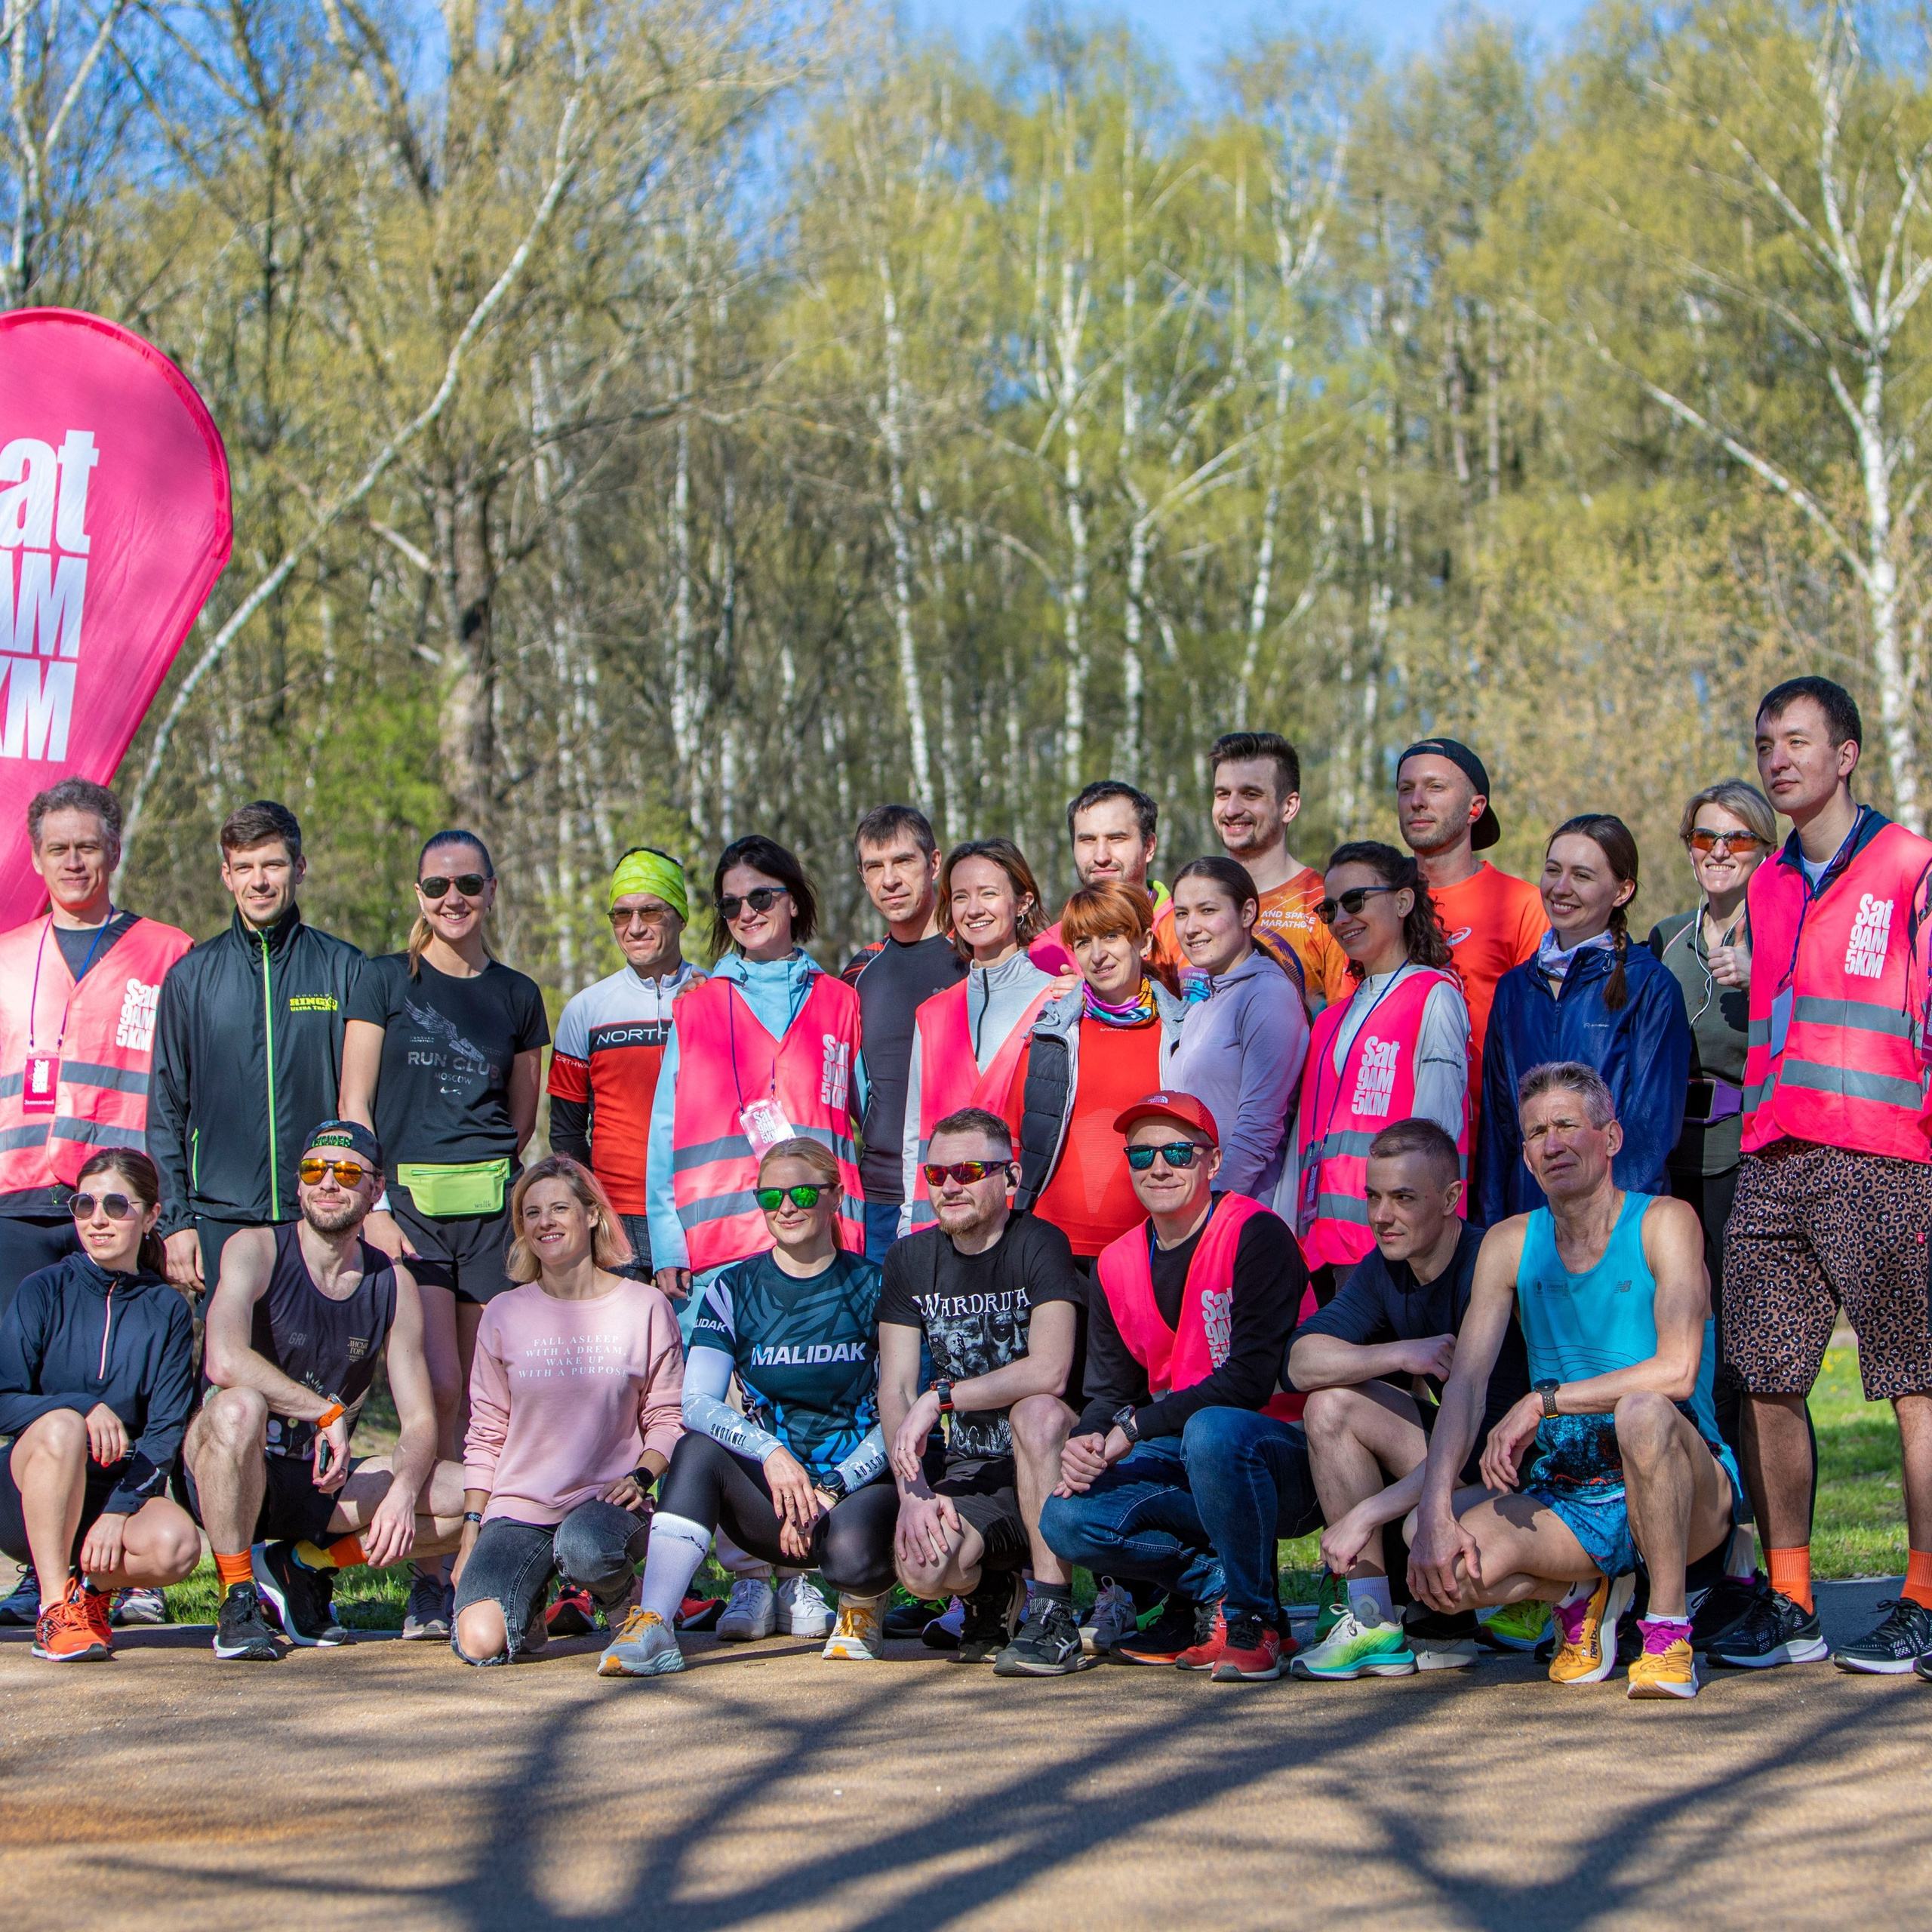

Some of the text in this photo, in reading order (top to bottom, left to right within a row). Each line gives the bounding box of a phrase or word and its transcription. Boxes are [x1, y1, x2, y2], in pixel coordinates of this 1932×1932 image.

[1261, 910, 1283, 918] AND
[1855, 893, 1894, 930] Sat
[1260, 919, 1313, 933] MARATHON
[1848, 924, 1890, 955] 9AM
[1844, 948, 1886, 979] 5KM
[124, 977, 160, 1010] Sat
[119, 1003, 156, 1031] 9AM
[115, 1023, 153, 1052] 5KM
[822, 1034, 850, 1069] Sat
[408, 1051, 500, 1079] RUN CLUB
[1361, 1035, 1401, 1070] Sat
[434, 1072, 473, 1085] MOSCOW
[822, 1060, 849, 1090] 9AM
[1356, 1066, 1396, 1094] 9AM
[820, 1081, 848, 1112] 5KM
[1351, 1089, 1391, 1118] 5KM
[752, 1108, 771, 1124] Sat
[757, 1118, 777, 1134] 9AM
[534, 1334, 619, 1347] FALL ASLEEP
[1204, 1318, 1232, 1346] 9A
[526, 1348, 558, 1357] WITH
[577, 1346, 626, 1356] DREAM,
[546, 1357, 582, 1366] WAKE
[752, 1342, 866, 1366] MALIDAK
[518, 1369, 552, 1378] WITH
[571, 1366, 628, 1378] PURPOSE
[1589, 1641, 1598, 1659] new
